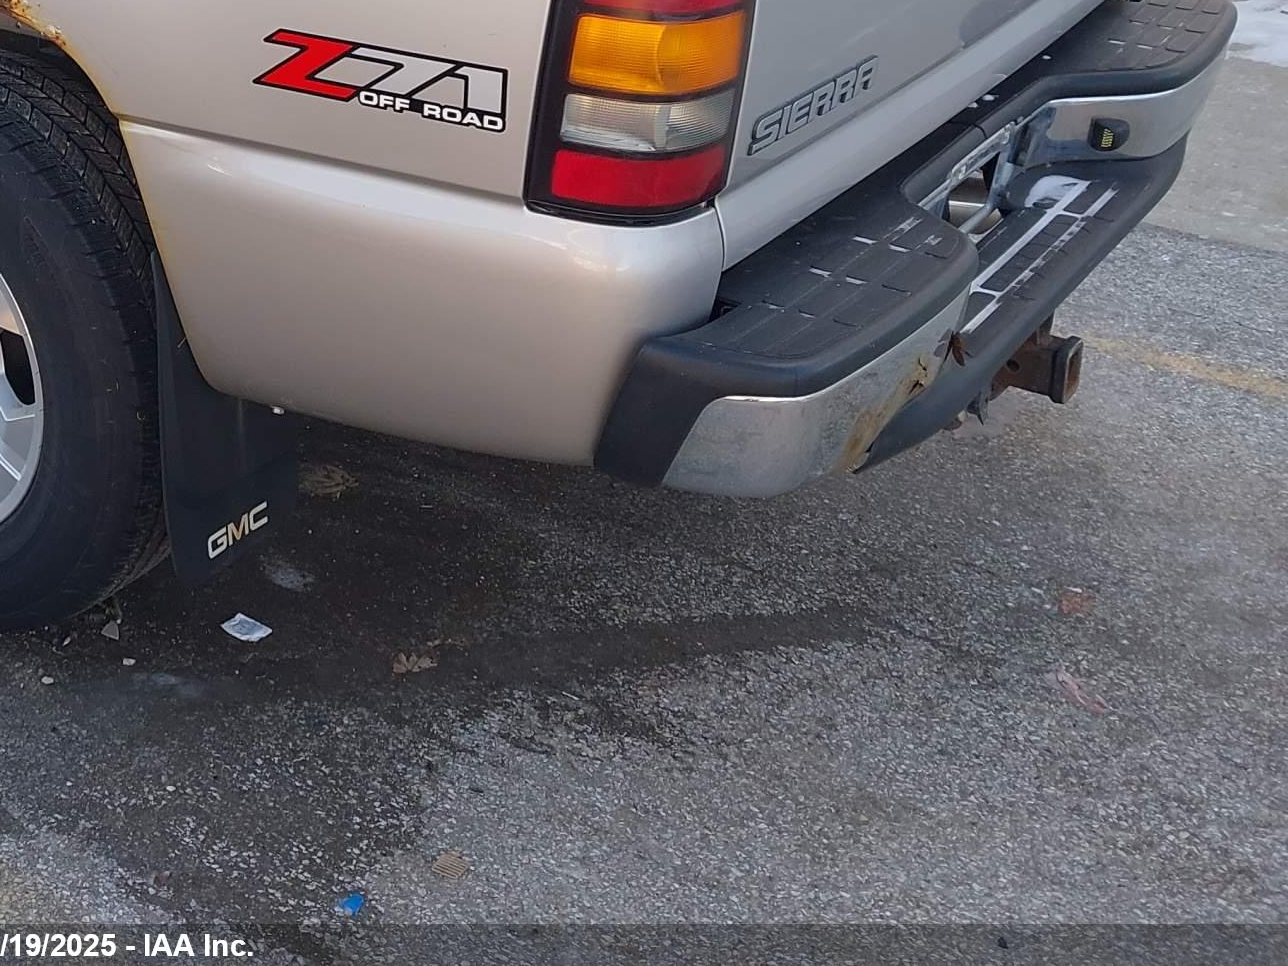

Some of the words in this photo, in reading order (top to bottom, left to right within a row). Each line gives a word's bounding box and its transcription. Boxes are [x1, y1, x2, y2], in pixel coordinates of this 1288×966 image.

[252, 28, 508, 115] Z71
[747, 54, 879, 156] SIERRA
[358, 89, 410, 111] OFF
[423, 103, 504, 131] ROAD
[207, 500, 269, 560] GMC
